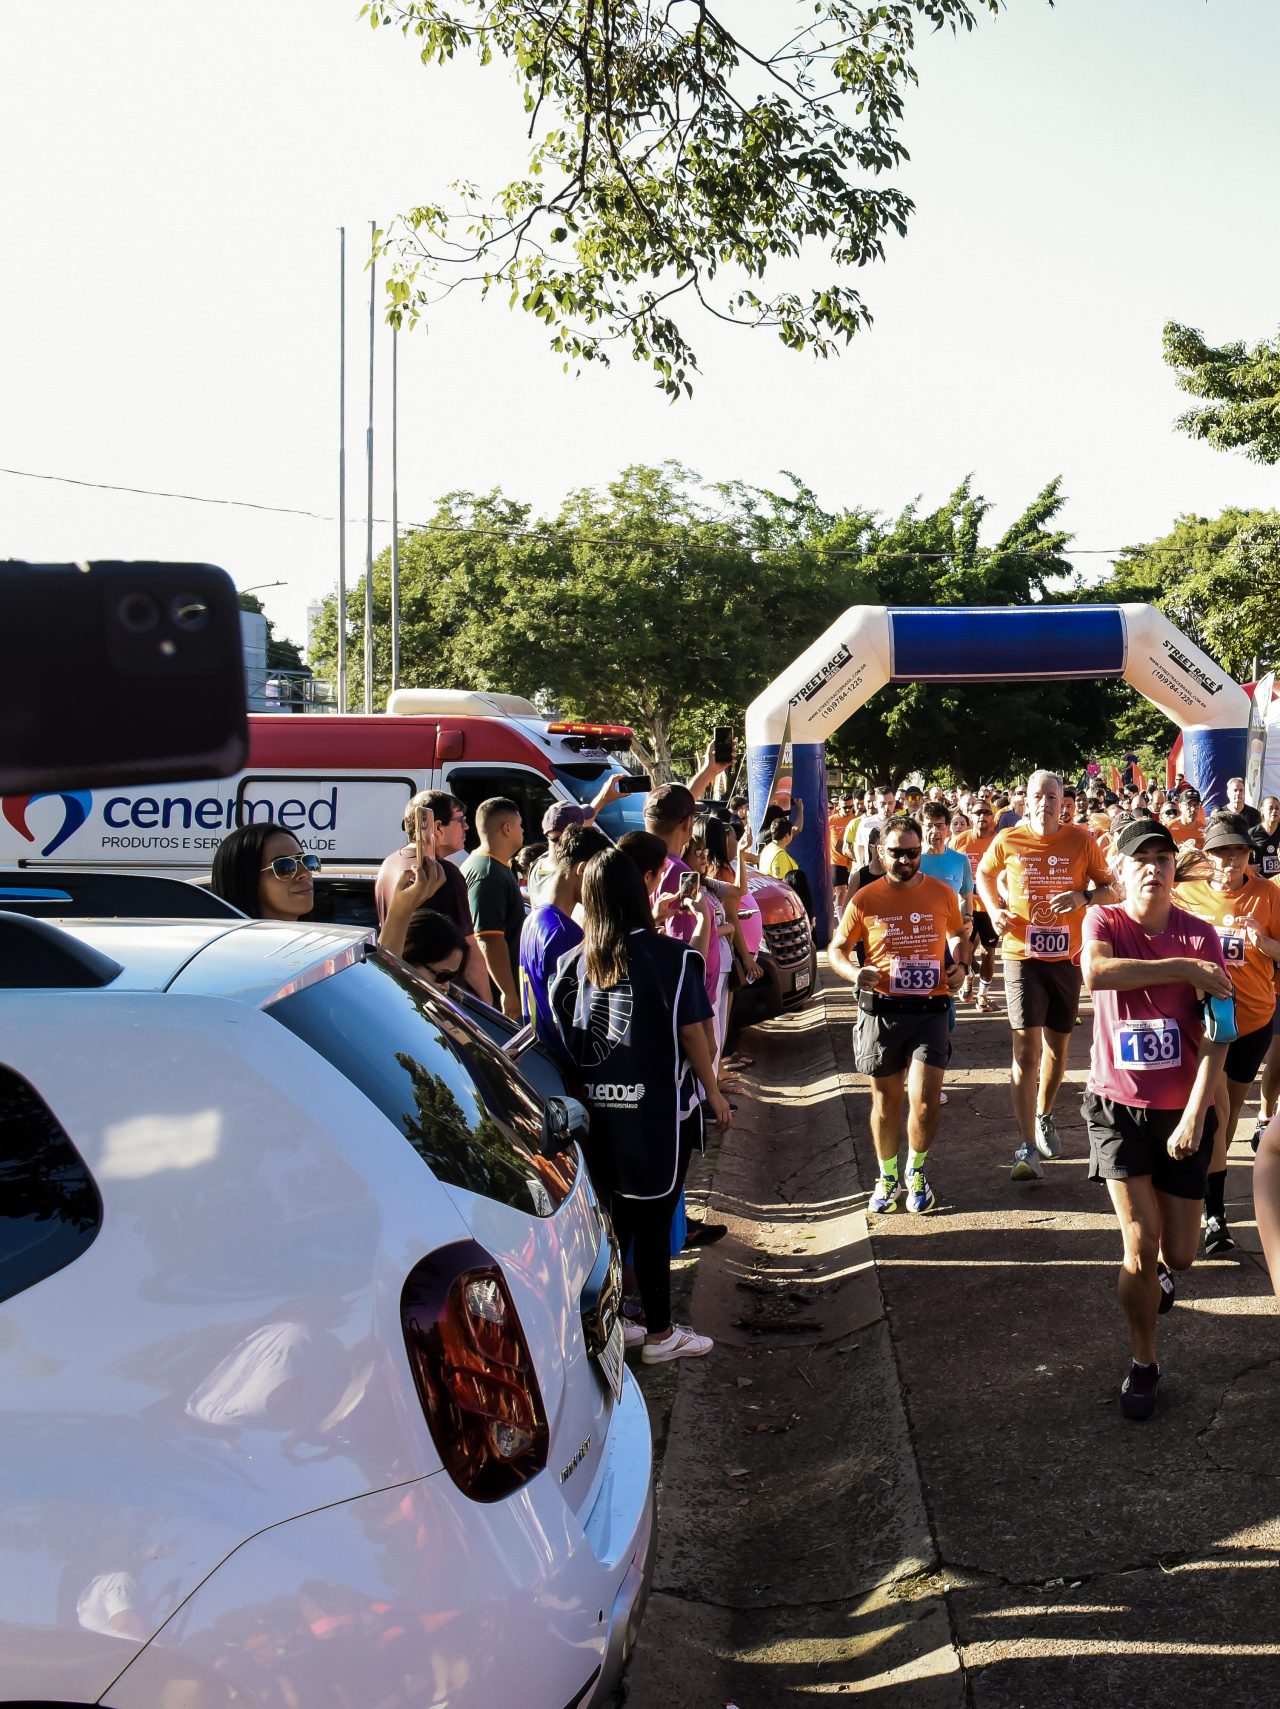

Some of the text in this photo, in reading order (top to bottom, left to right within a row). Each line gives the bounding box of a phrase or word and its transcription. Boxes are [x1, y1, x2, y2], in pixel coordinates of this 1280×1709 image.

[789, 651, 846, 707] STREET RACE
[1162, 640, 1217, 689] STREET RACE
[821, 677, 863, 718] (18)9784-1225
[1151, 669, 1194, 706] (18)9784-1225
[102, 786, 338, 831] cenemed
[101, 837, 179, 849] PRODUTOS
[183, 838, 191, 849] E
[301, 835, 336, 850] AÚDE
[1036, 934, 1066, 952] 800
[900, 969, 936, 989] 833
[1128, 1033, 1175, 1061] 138
